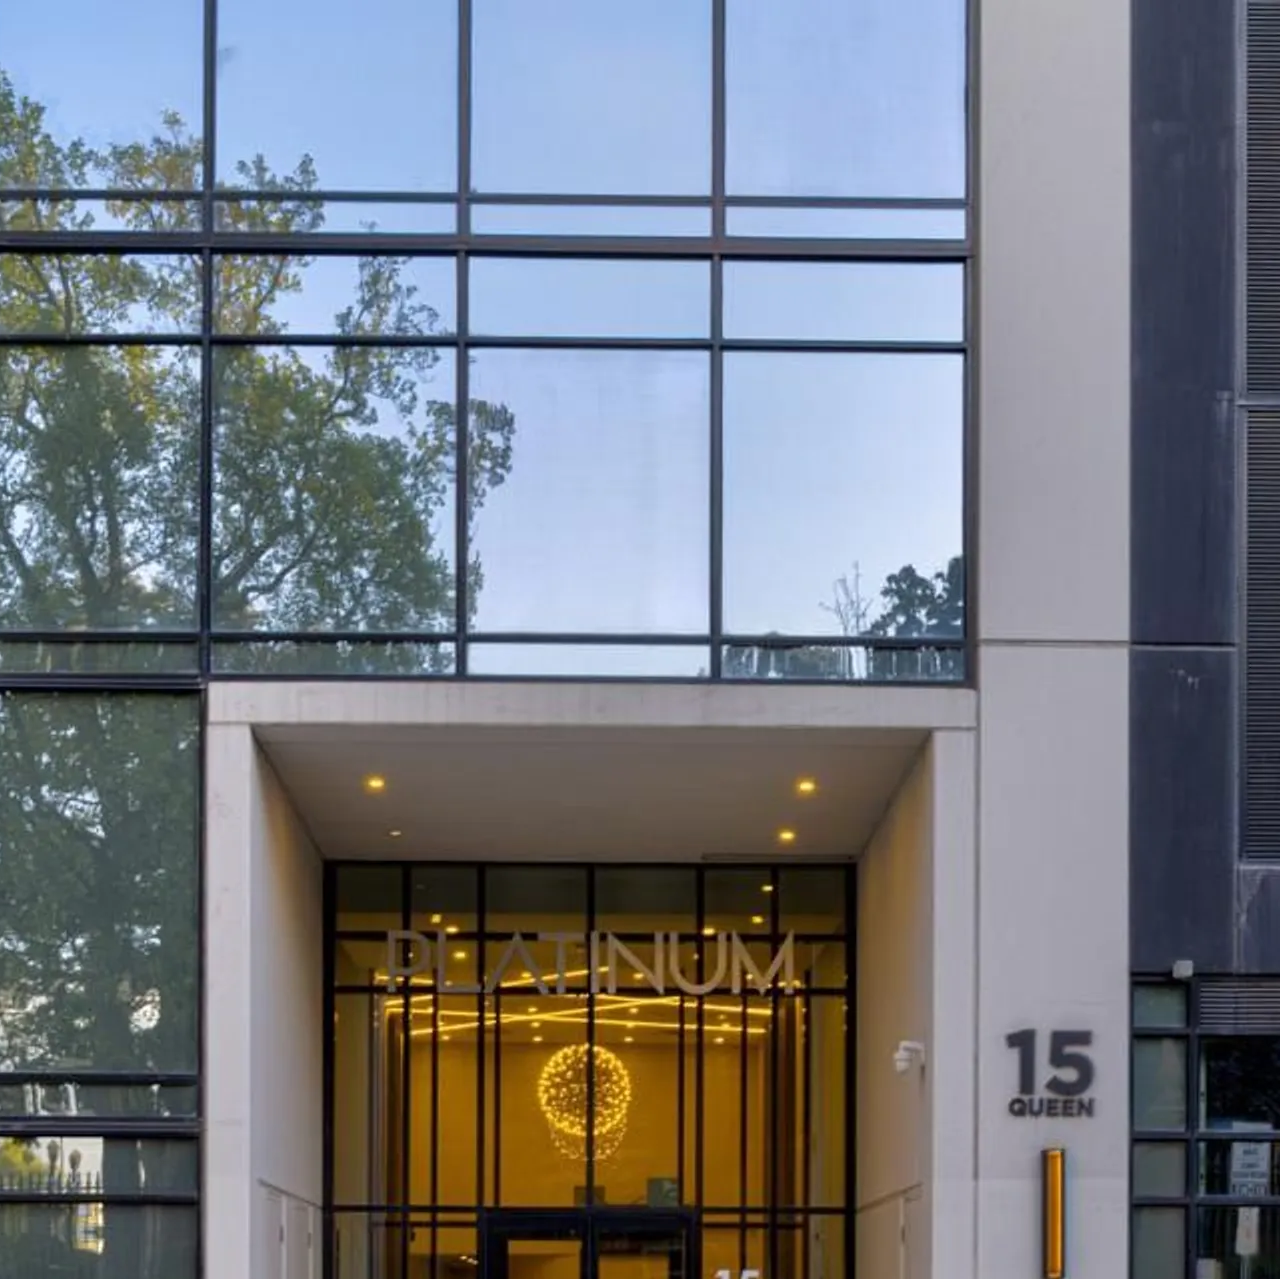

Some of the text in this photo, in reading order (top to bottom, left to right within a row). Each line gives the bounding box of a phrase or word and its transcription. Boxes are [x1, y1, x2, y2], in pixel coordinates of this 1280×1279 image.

[386, 929, 795, 996] PLATINUM
[1005, 1028, 1094, 1096] 15
[1008, 1098, 1096, 1118] QUEEN
